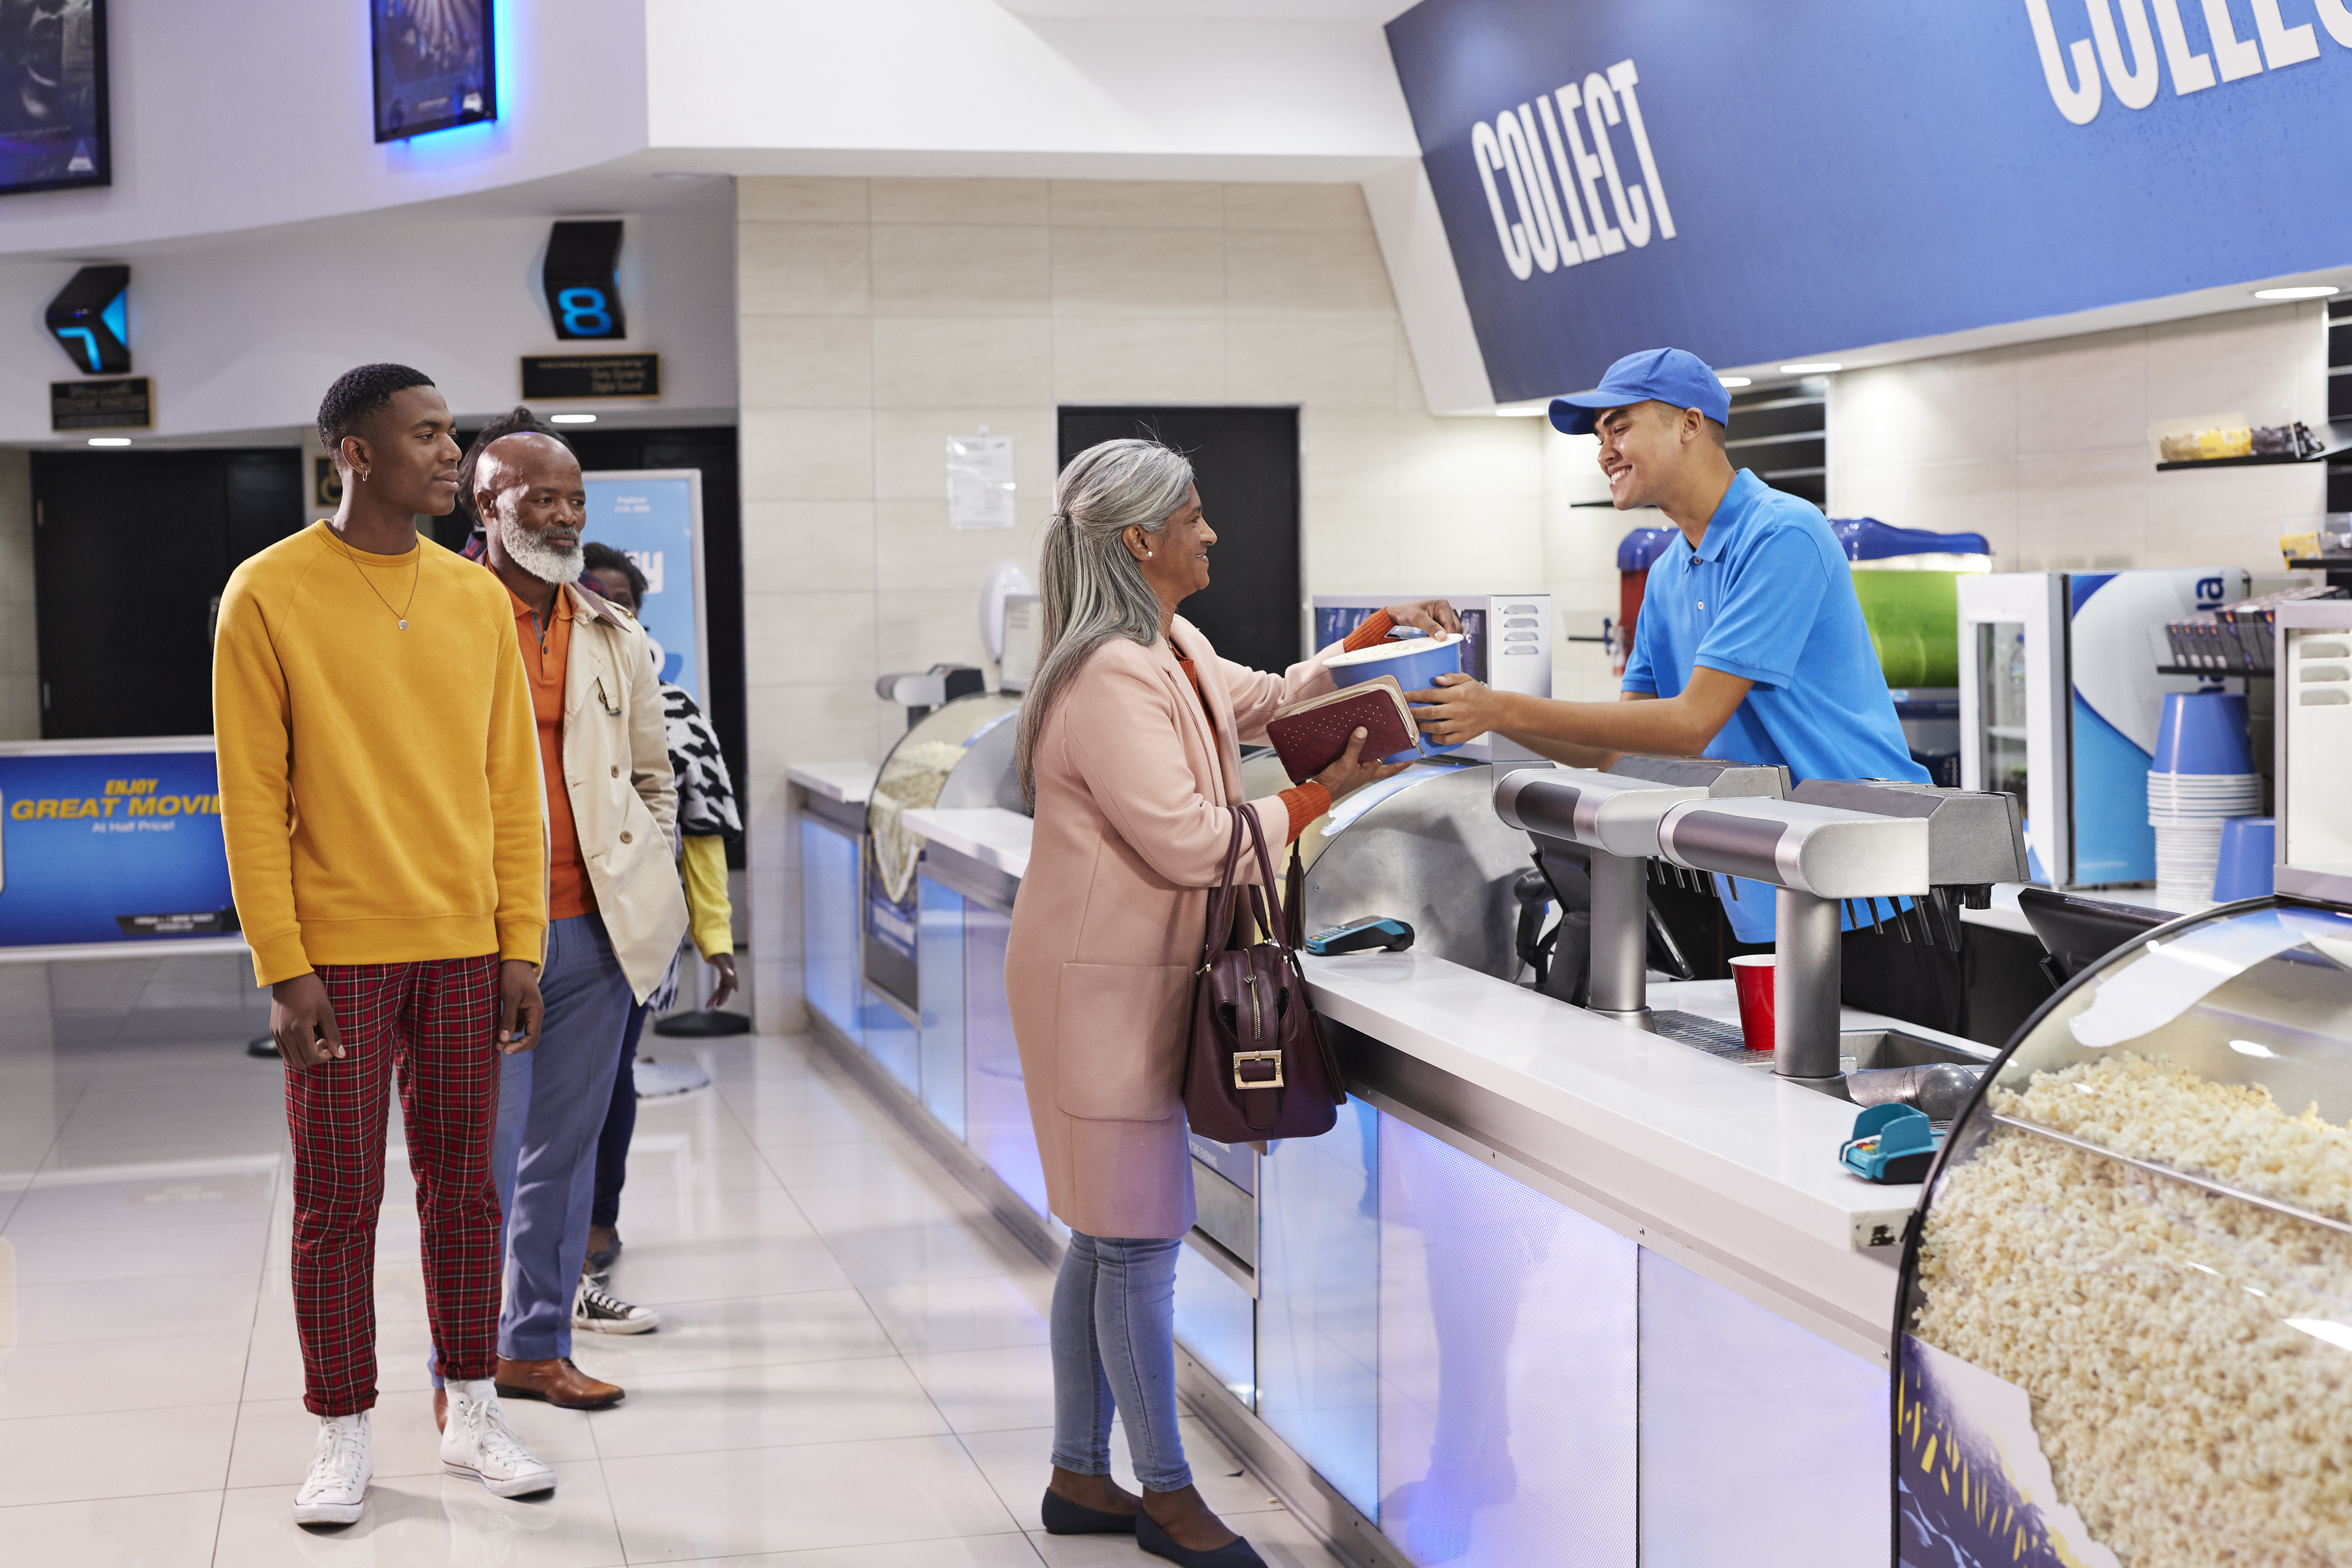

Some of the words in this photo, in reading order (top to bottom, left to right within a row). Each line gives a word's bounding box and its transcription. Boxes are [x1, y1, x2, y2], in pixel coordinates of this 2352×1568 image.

[1472, 59, 1677, 280] COLLECT
[558, 287, 612, 336] 8
[56, 327, 102, 371] 7
[11, 797, 121, 820] GREAT
[105, 778, 159, 796] ENJOY
